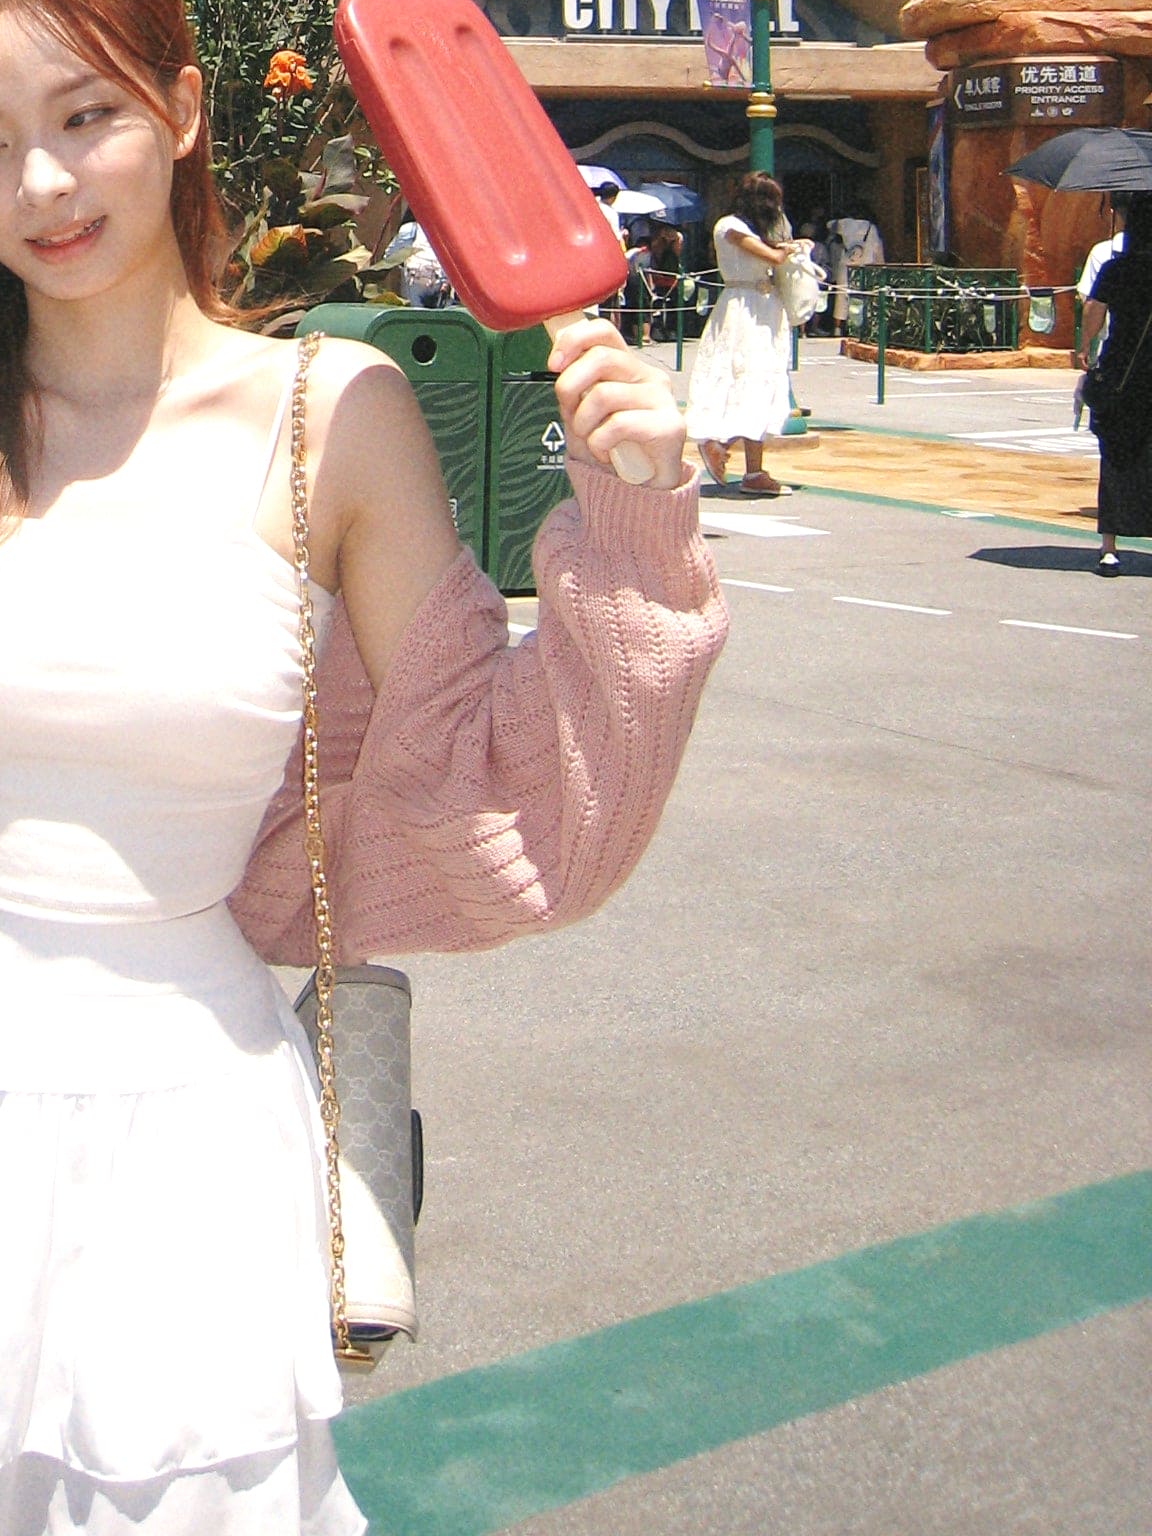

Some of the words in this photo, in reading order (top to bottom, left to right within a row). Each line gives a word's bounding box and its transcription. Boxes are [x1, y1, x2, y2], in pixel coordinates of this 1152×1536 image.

[1020, 65, 1097, 84] 优先通道
[1014, 86, 1061, 95] PRIORITY
[1064, 85, 1105, 94] ACCESS
[1030, 95, 1087, 105] ENTRANCE
